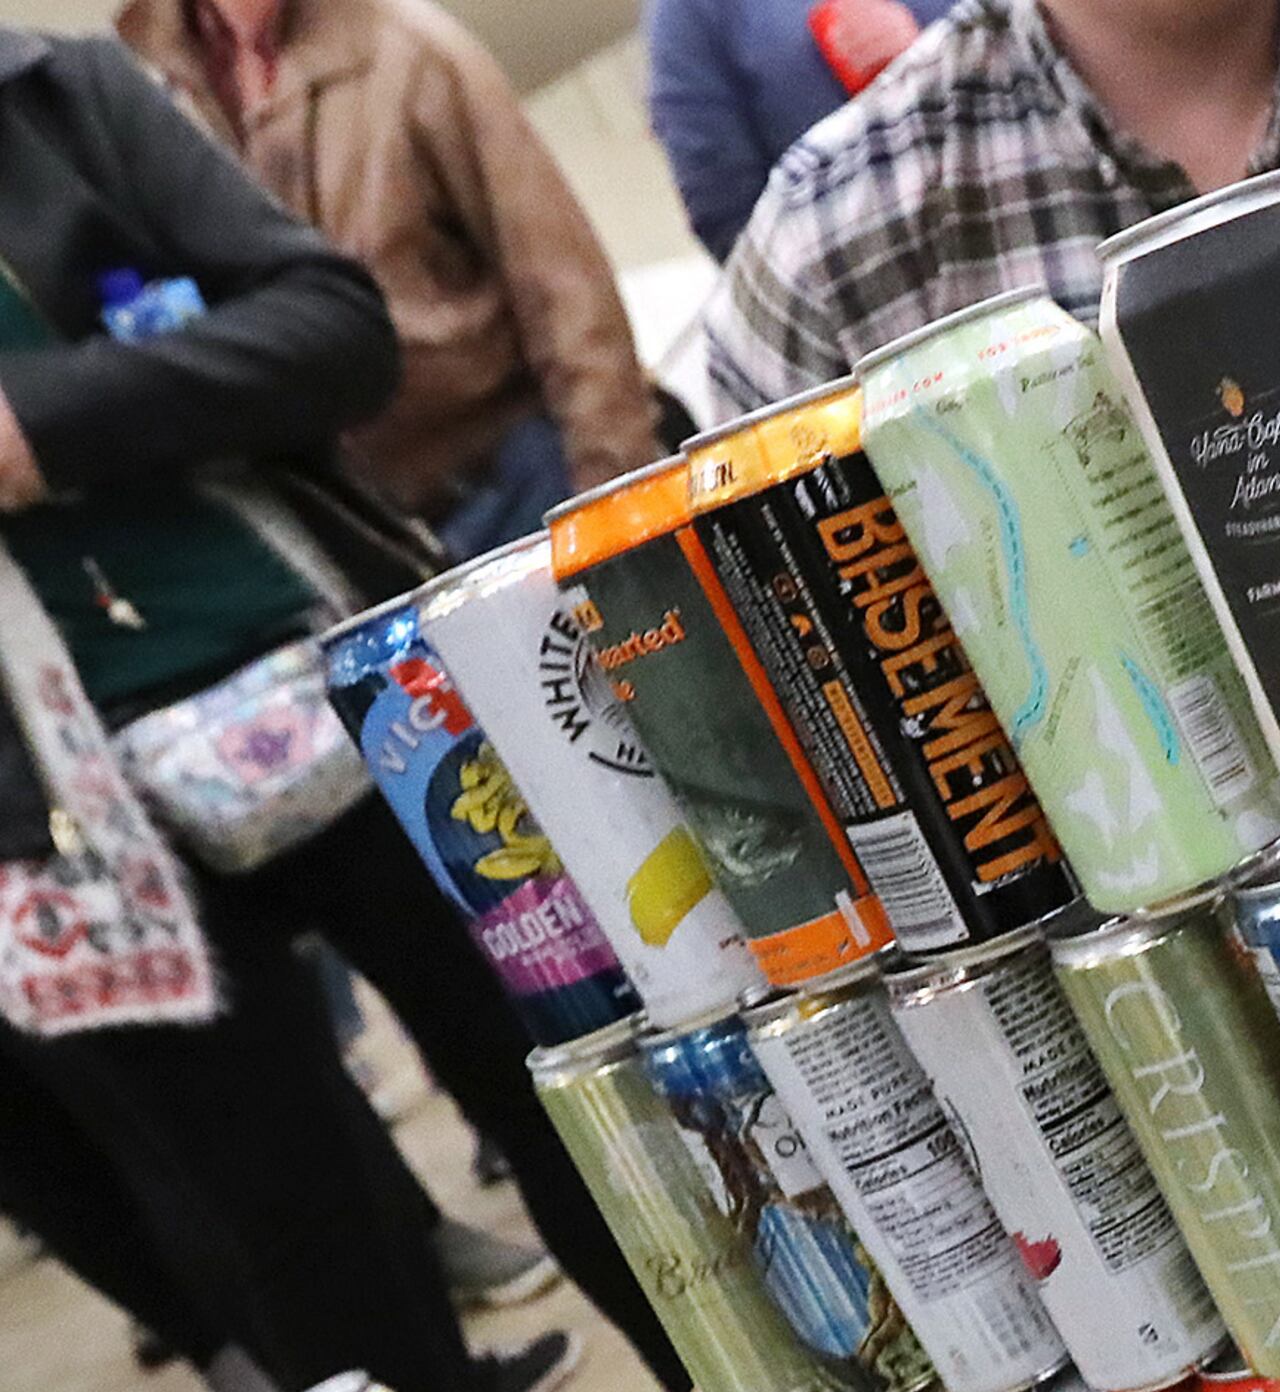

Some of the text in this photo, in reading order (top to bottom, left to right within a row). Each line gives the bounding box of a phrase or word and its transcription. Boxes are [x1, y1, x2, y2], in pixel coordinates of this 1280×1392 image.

[1247, 451, 1270, 474] in
[539, 610, 590, 743] WHITE
[482, 884, 583, 959] GOLDEN
